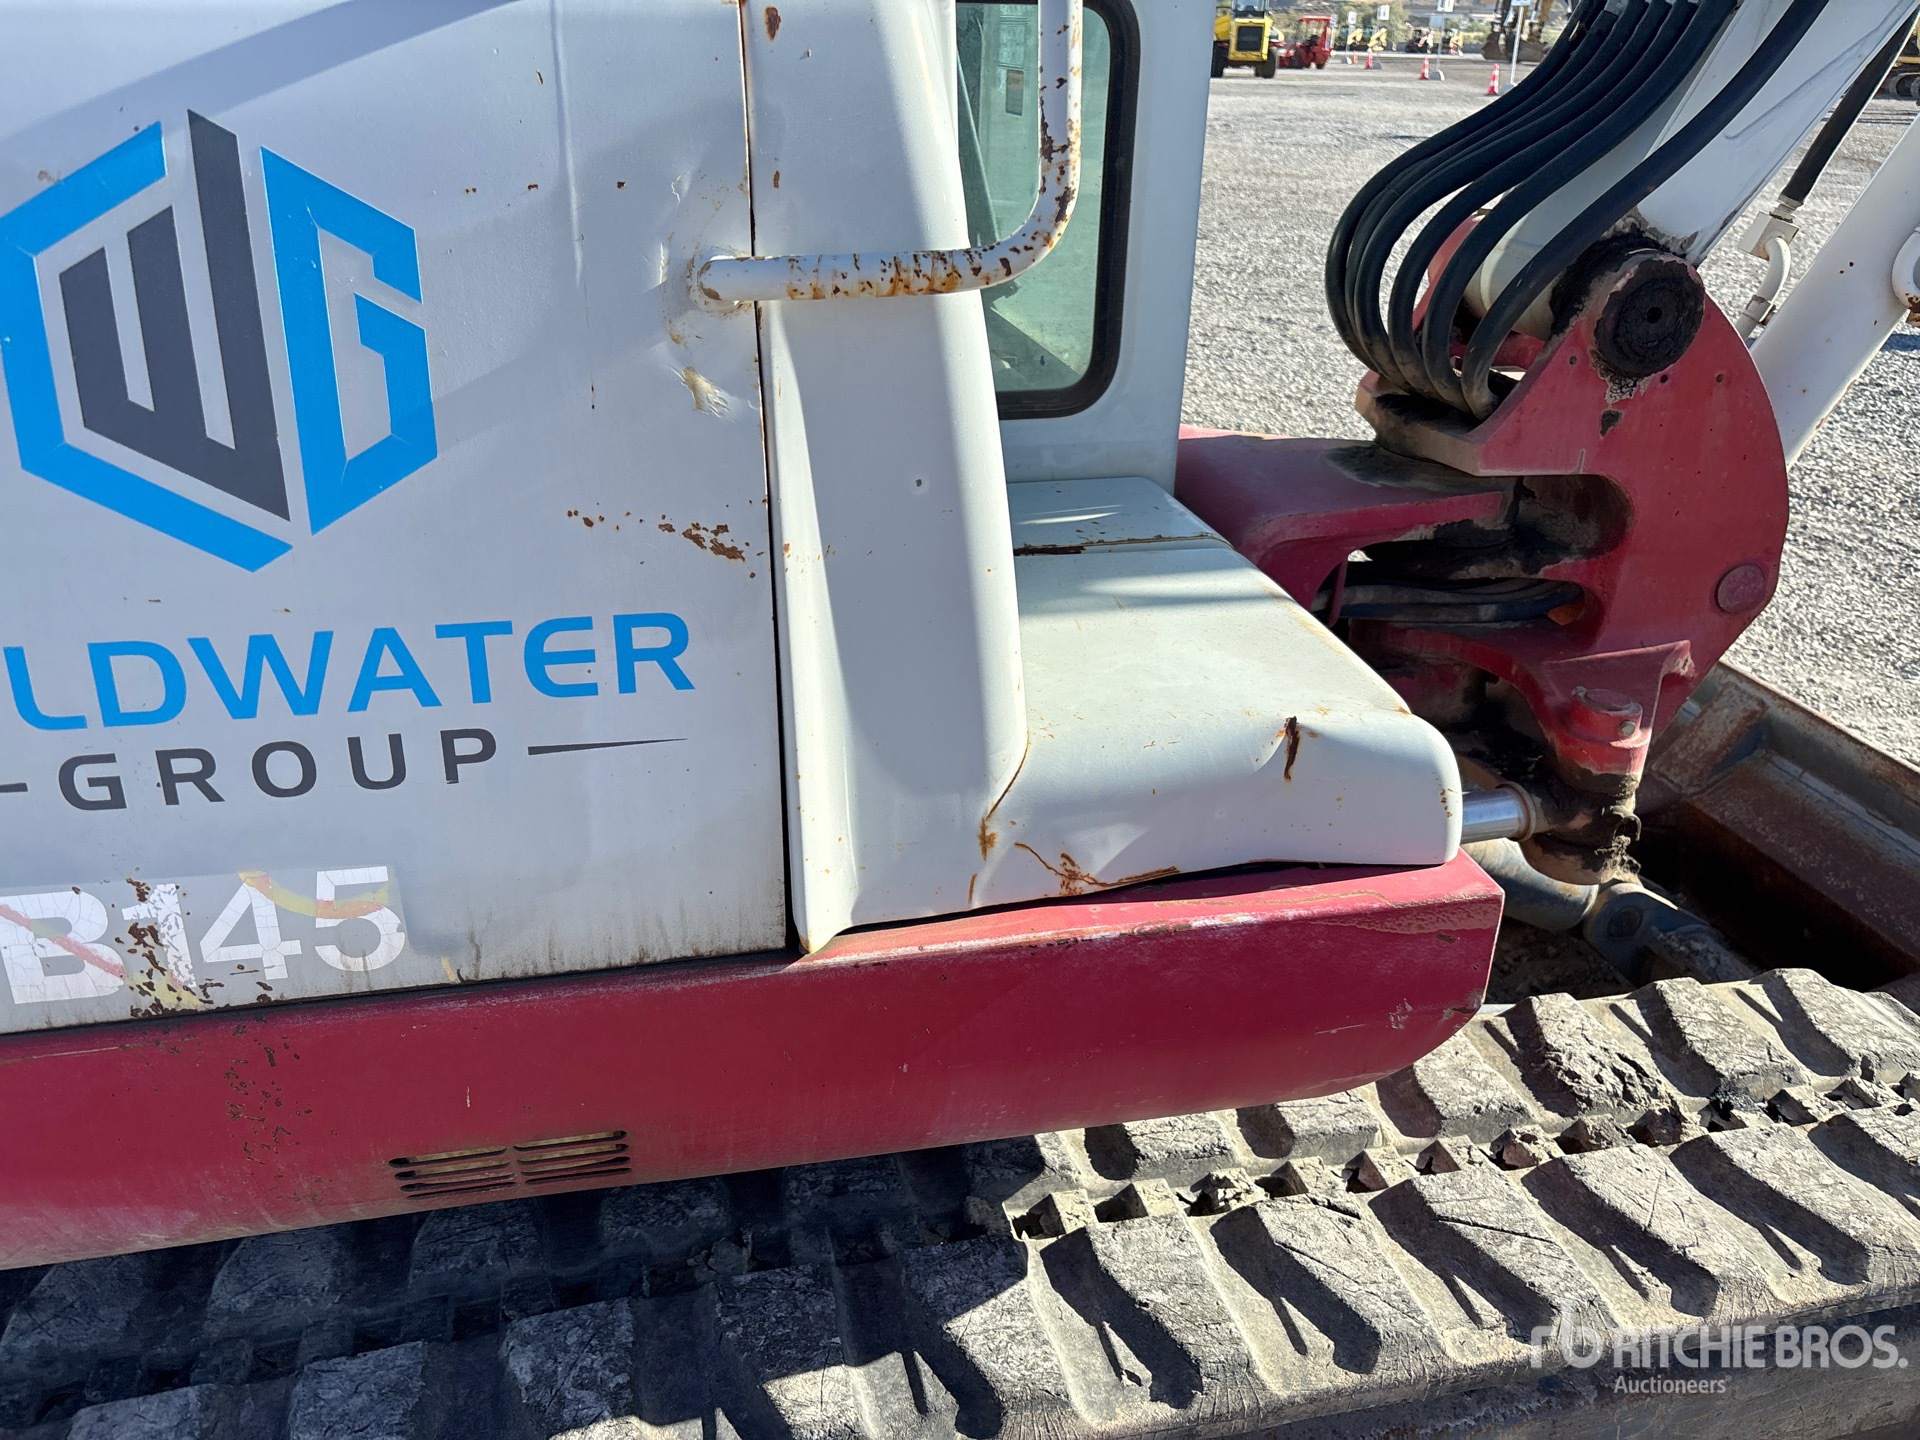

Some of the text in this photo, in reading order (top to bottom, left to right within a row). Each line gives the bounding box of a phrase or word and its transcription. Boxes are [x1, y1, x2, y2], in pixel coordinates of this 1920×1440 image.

[3, 612, 695, 731] LDWATER
[58, 728, 497, 811] GROUP
[0, 865, 406, 1004] B145
